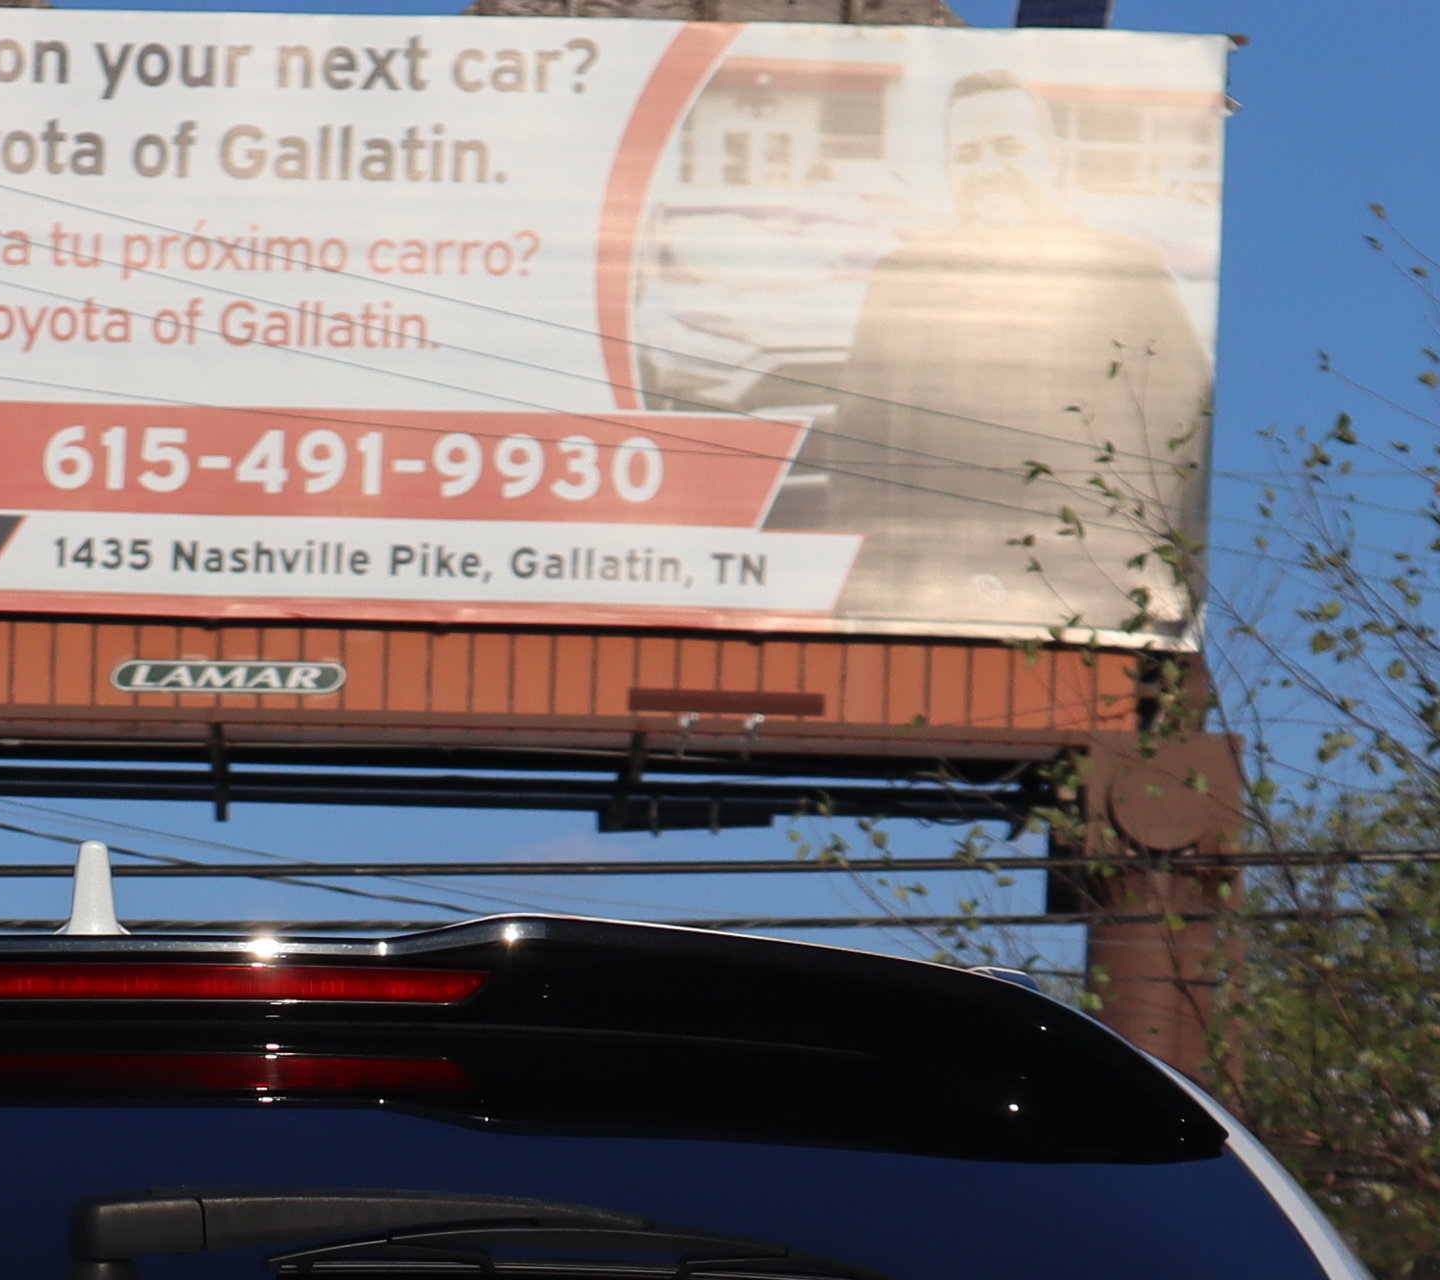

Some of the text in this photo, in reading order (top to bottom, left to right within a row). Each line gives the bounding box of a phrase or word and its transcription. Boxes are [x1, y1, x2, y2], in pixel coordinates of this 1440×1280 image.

[94, 41, 253, 100] your
[276, 35, 430, 92] next
[451, 37, 601, 94] car?
[132, 119, 198, 178] of
[220, 122, 511, 185] Gallatin.
[49, 221, 103, 268] tu
[121, 218, 350, 280] próximo
[366, 228, 544, 277] carro?
[150, 297, 206, 345] of
[219, 298, 442, 350] Gallatin.
[42, 424, 665, 504] 615-491-9930
[54, 536, 768, 588] 1435 Nashville Pike, Gallatin, TN
[129, 664, 322, 689] LAMAR
